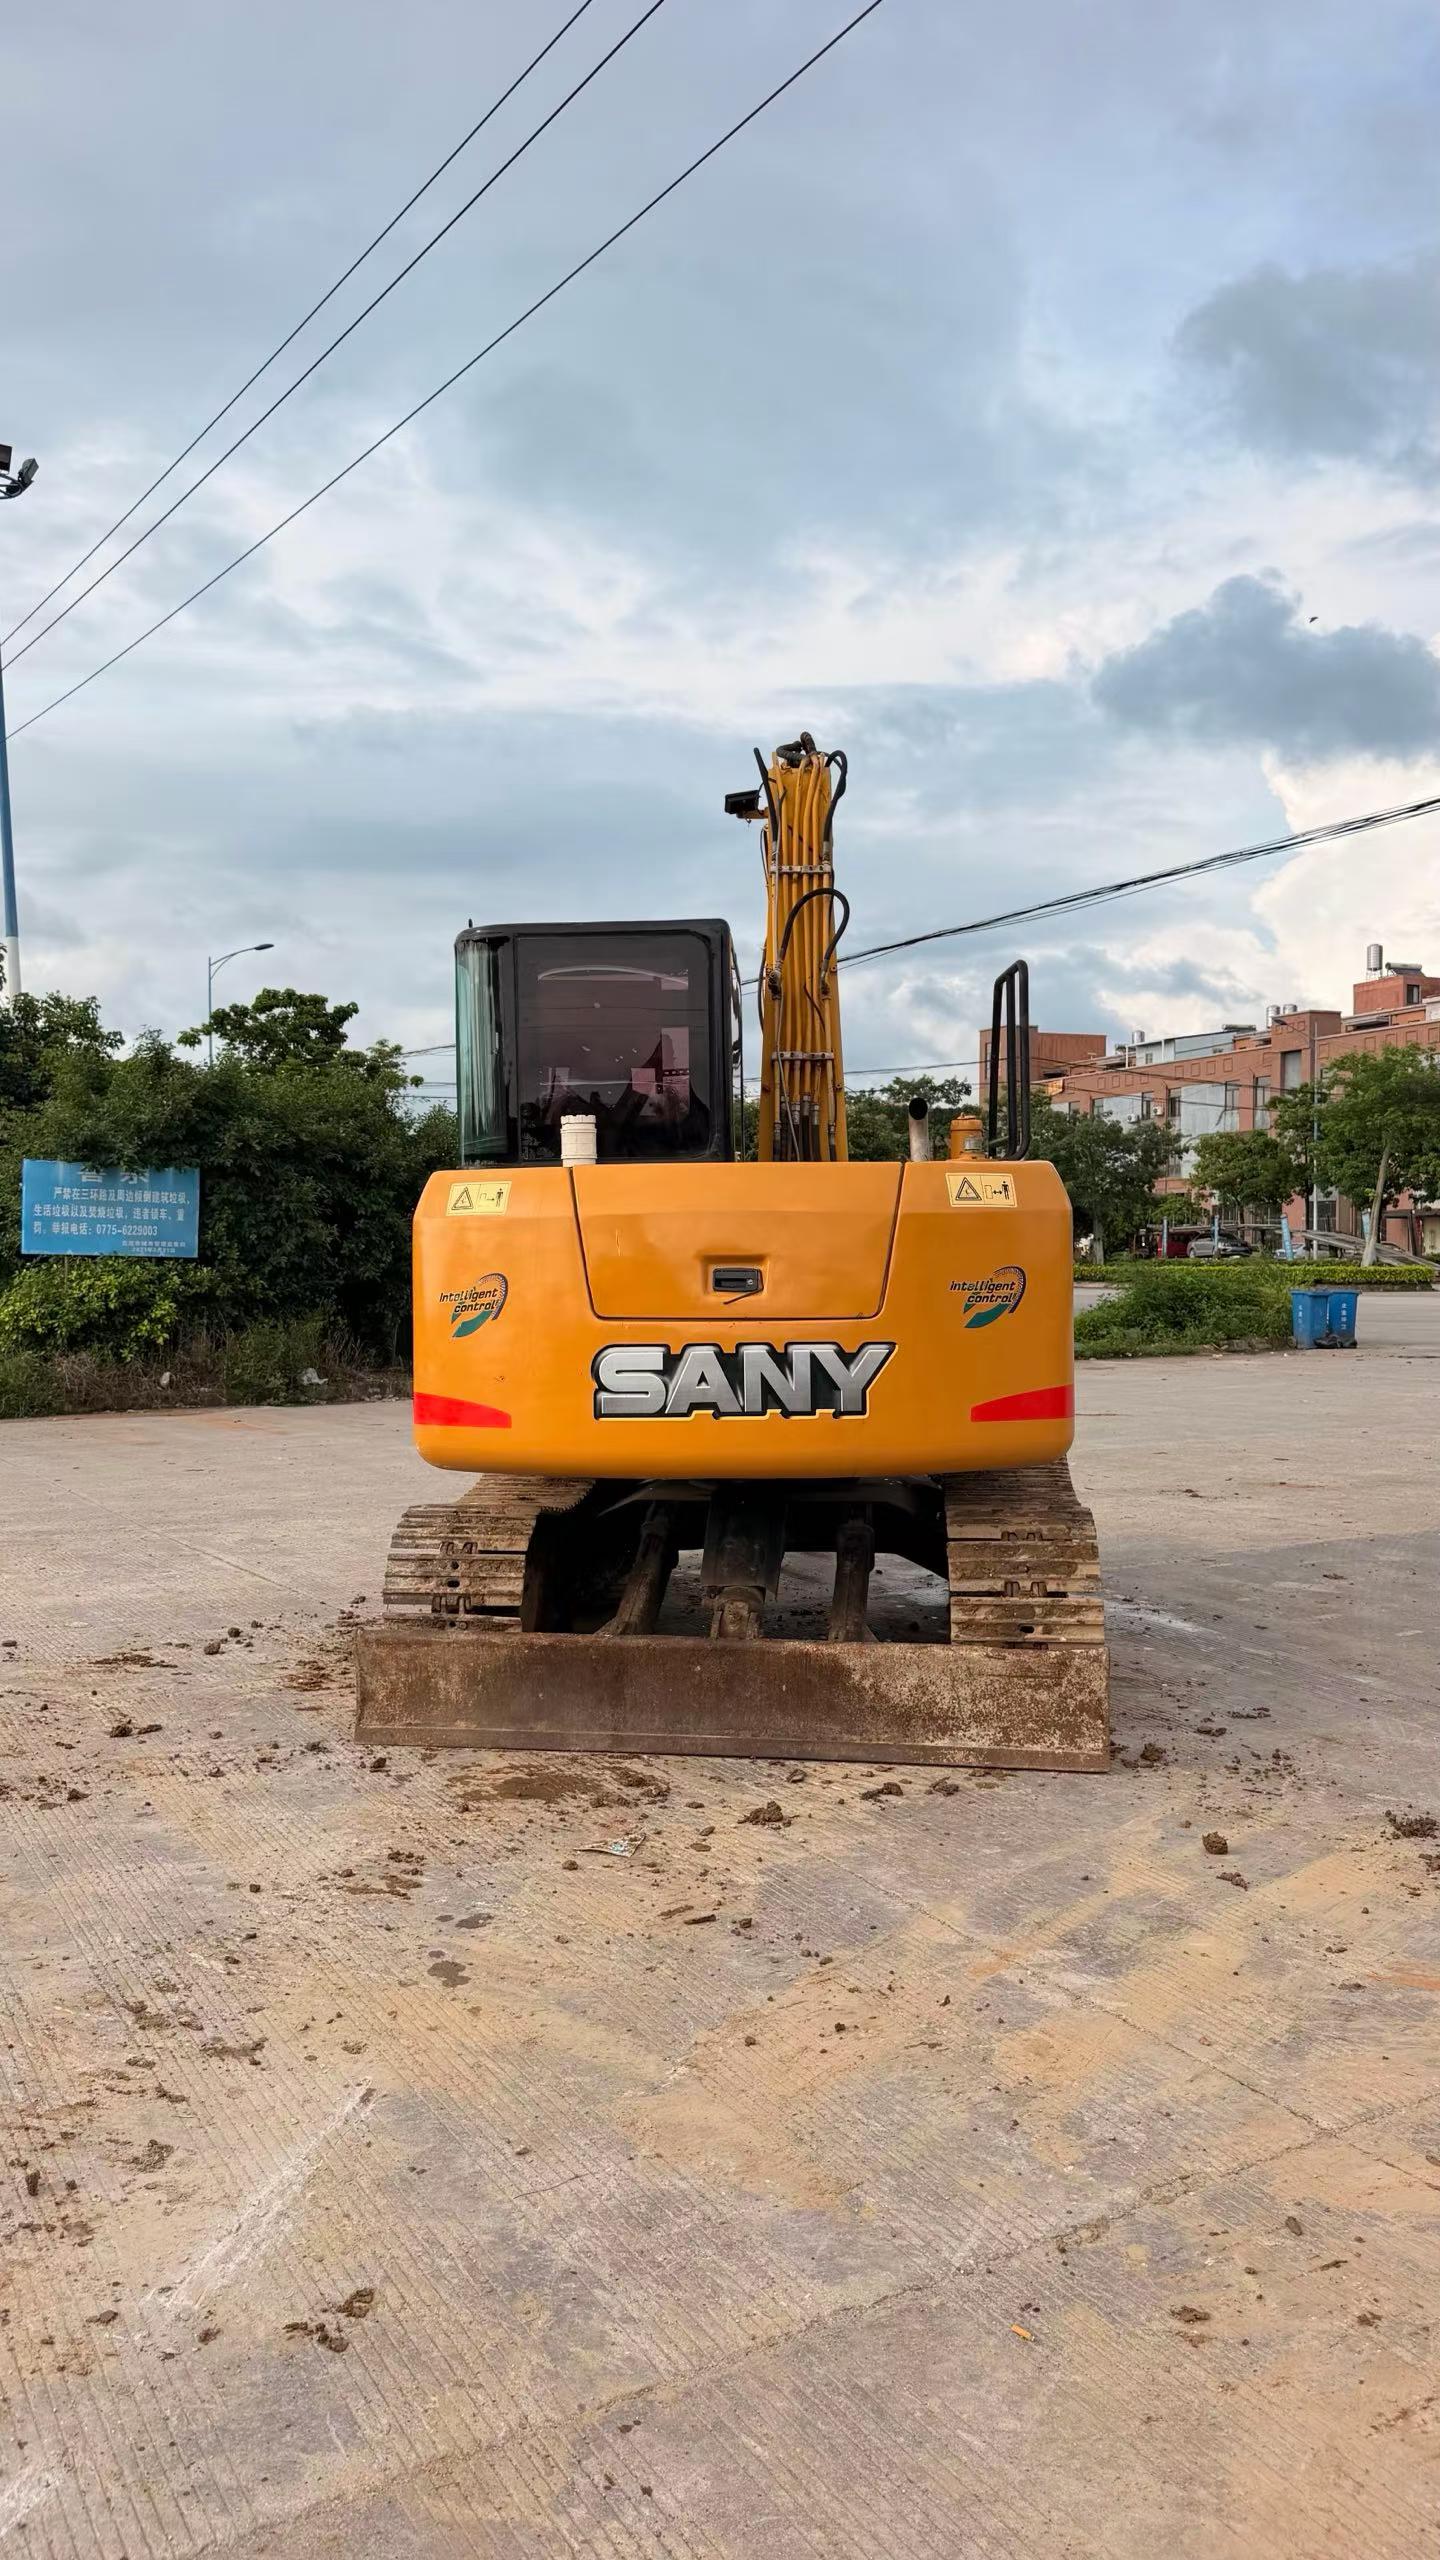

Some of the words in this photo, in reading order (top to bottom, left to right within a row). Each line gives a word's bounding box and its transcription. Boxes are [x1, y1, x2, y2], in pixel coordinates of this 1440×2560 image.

[967, 1293, 1013, 1303] control
[454, 1300, 496, 1313] control
[591, 1342, 897, 1419] SANY
